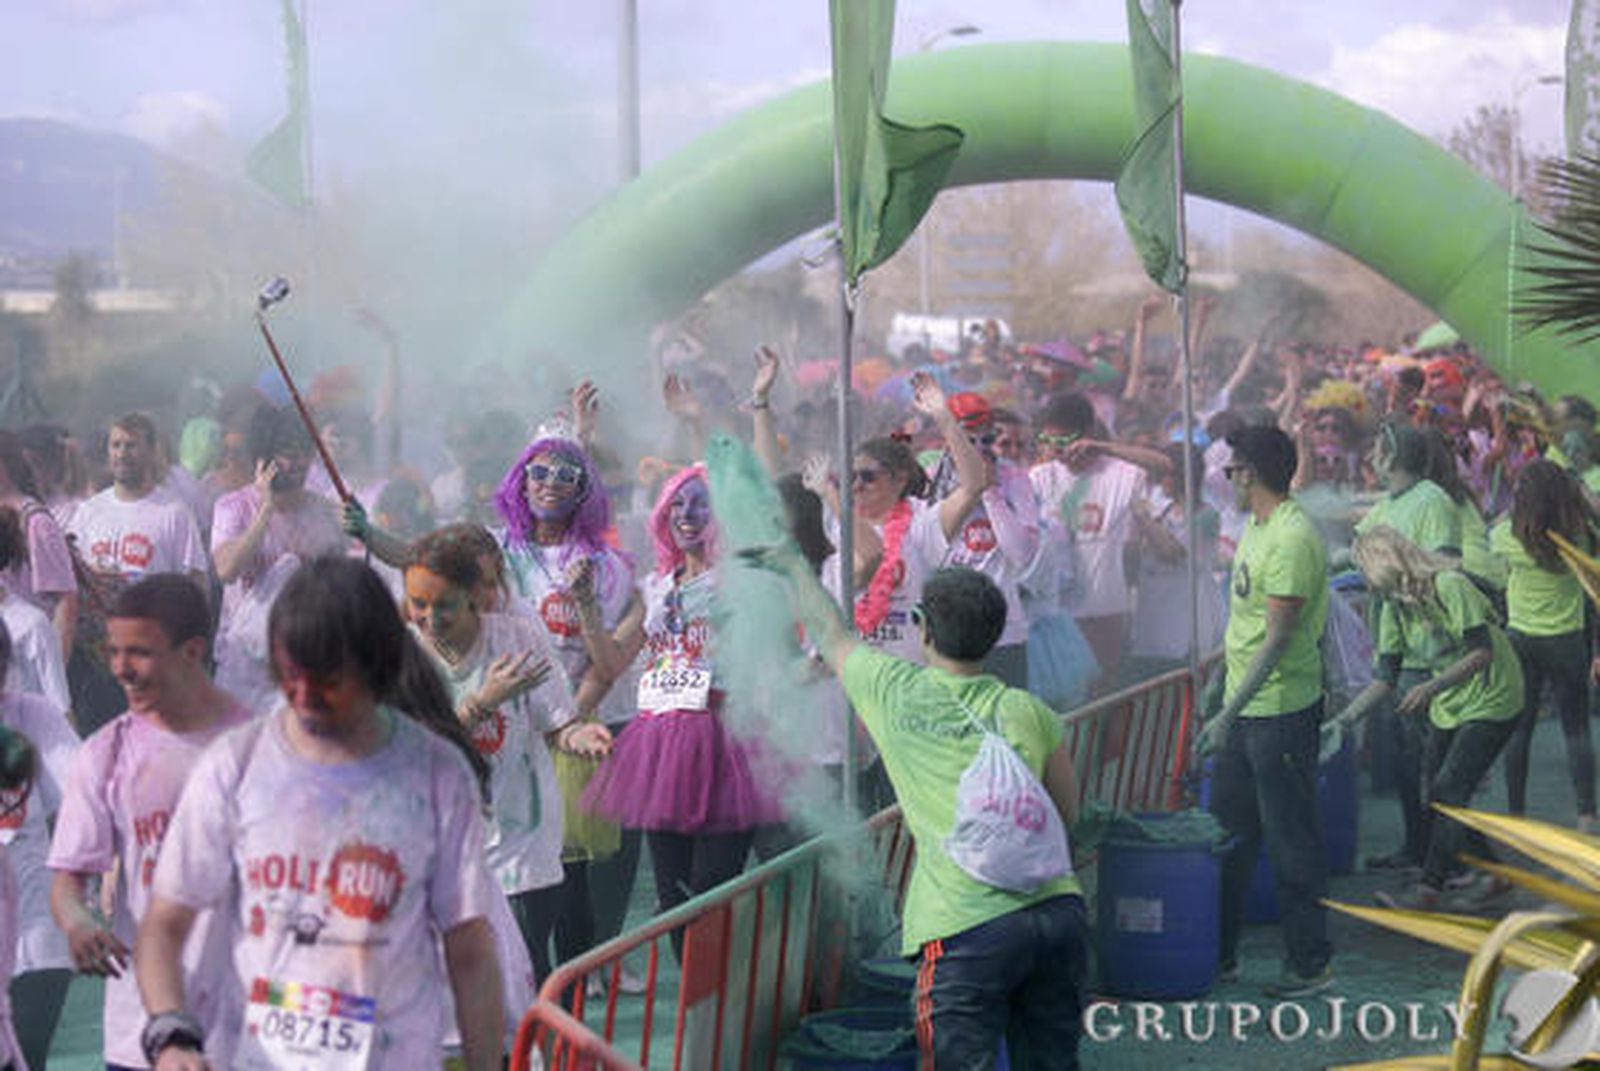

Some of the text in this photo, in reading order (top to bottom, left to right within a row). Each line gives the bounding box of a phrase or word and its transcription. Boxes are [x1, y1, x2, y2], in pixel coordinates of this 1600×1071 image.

[246, 852, 398, 906] HOLI RUN
[262, 1008, 354, 1052] 08715
